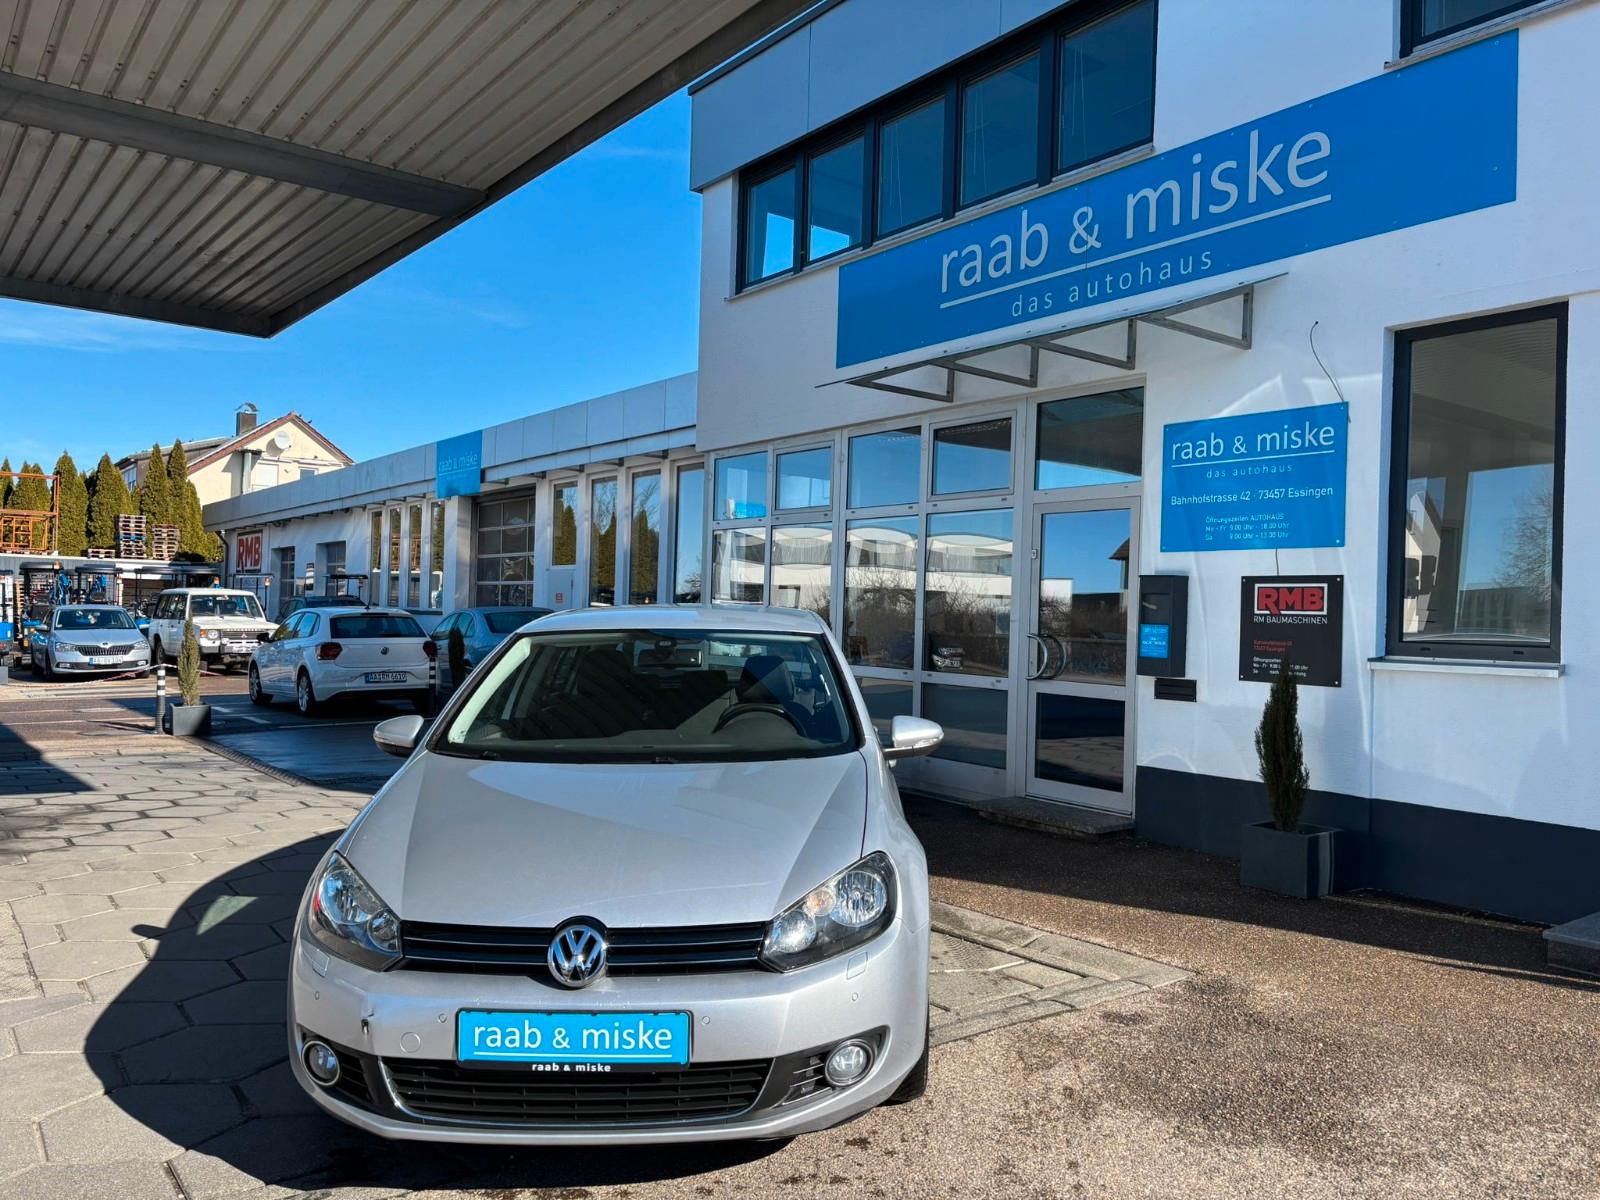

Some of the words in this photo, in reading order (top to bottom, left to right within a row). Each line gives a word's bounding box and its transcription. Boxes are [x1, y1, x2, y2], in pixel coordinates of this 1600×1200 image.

[942, 210, 1049, 294] raab
[1069, 205, 1102, 255] &
[1126, 128, 1332, 240] miske
[1012, 288, 1054, 318] das
[1069, 250, 1212, 303] autohaus
[1171, 431, 1225, 461] raab
[1233, 434, 1248, 455] &
[1256, 420, 1336, 453] miske
[1206, 467, 1227, 480] das
[1232, 463, 1293, 478] autohaus
[1171, 491, 1238, 506] Bahnhofstrasse
[1239, 490, 1251, 502] 42
[1258, 487, 1286, 500] 73457
[1288, 485, 1334, 500] Essingen
[1250, 512, 1285, 521] AUTOHAUS
[238, 535, 260, 574] RMB
[1258, 587, 1323, 615] RMB
[1254, 615, 1265, 624] RM
[1266, 615, 1328, 625] BAUMASCHINEN
[473, 1019, 543, 1049] raab
[552, 1027, 571, 1049] &
[582, 1020, 673, 1050] miske
[532, 1063, 560, 1072] raab
[575, 1062, 612, 1073] miske
